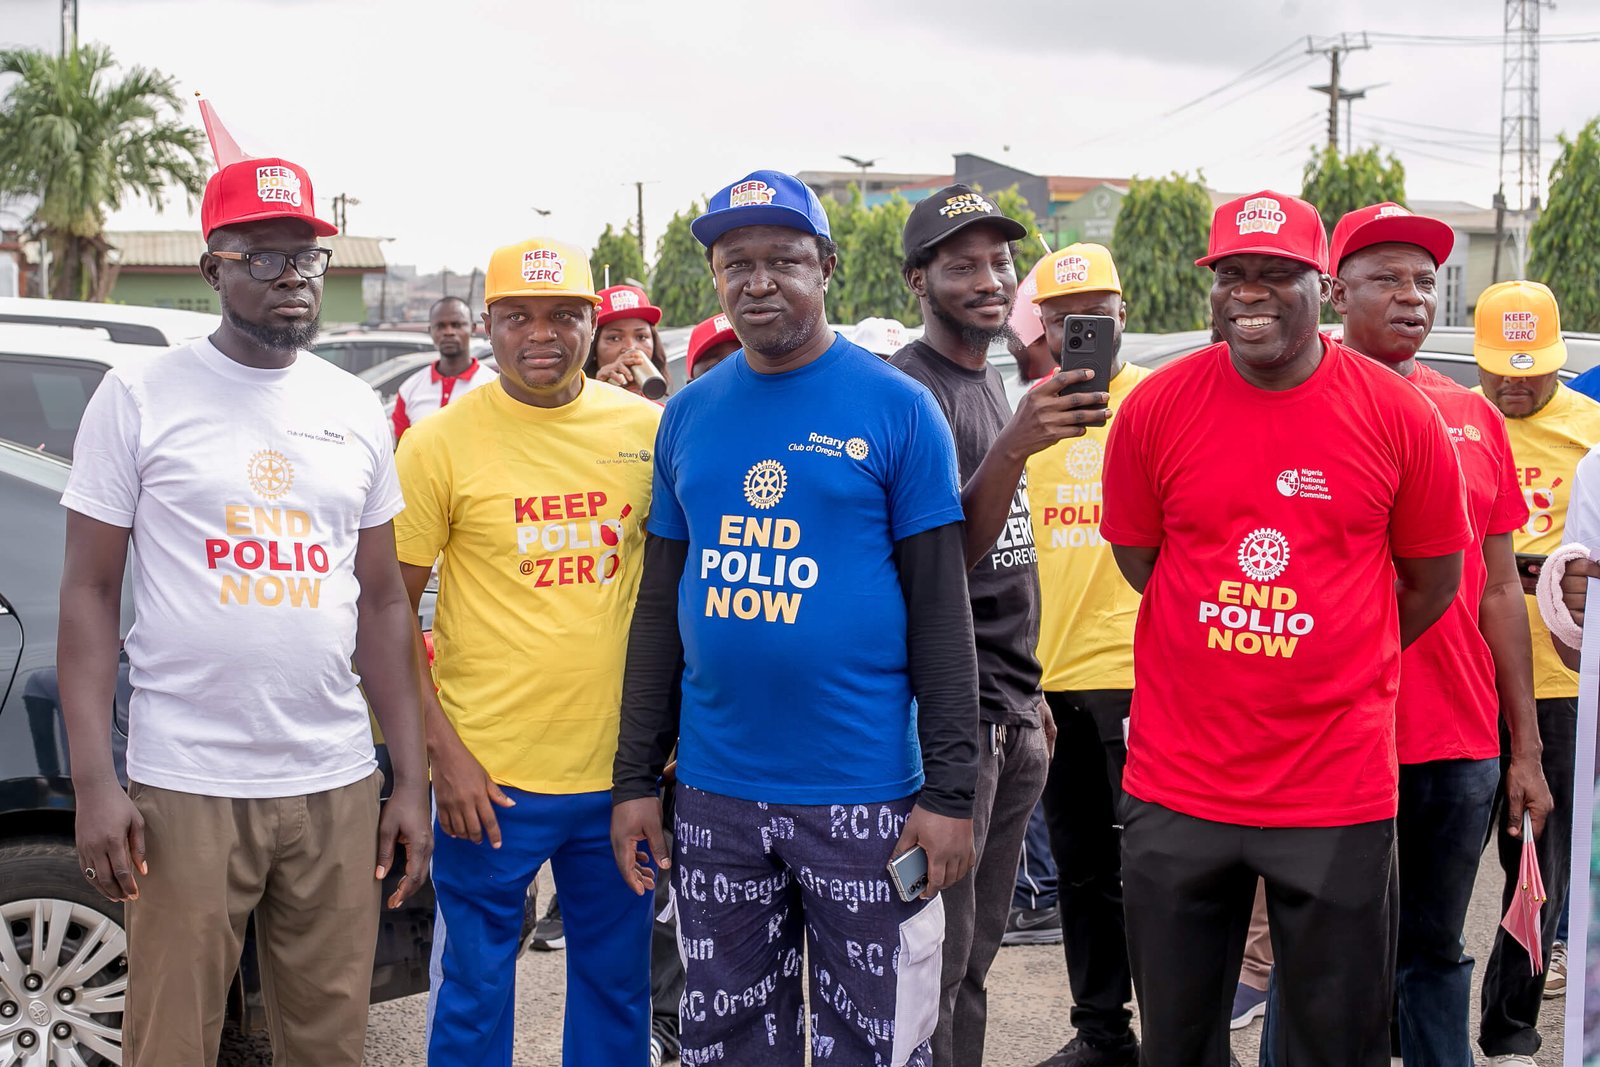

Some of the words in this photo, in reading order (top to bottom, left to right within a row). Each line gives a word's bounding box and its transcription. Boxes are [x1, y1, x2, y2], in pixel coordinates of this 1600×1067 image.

[731, 181, 765, 196] KEEP
[1238, 209, 1284, 223] POLIO
[1246, 199, 1278, 211] END
[1241, 220, 1278, 233] NOW
[525, 250, 558, 261] KEEP
[1057, 256, 1082, 268] KEEP
[1505, 313, 1531, 321] KEEP
[808, 432, 845, 449] Rotary
[1448, 427, 1463, 436] ary
[788, 443, 804, 451] Club
[805, 444, 815, 452] of
[815, 445, 842, 458] Oregun
[1300, 476, 1327, 485] National
[1301, 468, 1323, 477] Nigeria
[1516, 467, 1542, 487] EP
[1299, 490, 1332, 501] Committee
[1300, 484, 1329, 493] PolioPlus
[514, 491, 607, 524] KEEP
[1043, 504, 1100, 526] POLI
[225, 504, 312, 537] END
[517, 518, 625, 555] POLIO
[719, 515, 801, 550] END
[205, 538, 329, 574] POLIO
[991, 547, 1038, 570] FOREVE
[519, 548, 620, 589] @ZERO
[700, 548, 819, 589] POLIO
[219, 574, 321, 608] NOW
[1218, 580, 1298, 611] END
[705, 586, 803, 625] NOW
[1198, 601, 1315, 636] POLIO
[1207, 626, 1299, 658] NOW
[713, 872, 789, 905] Oregu
[713, 970, 778, 1017] Oregu
